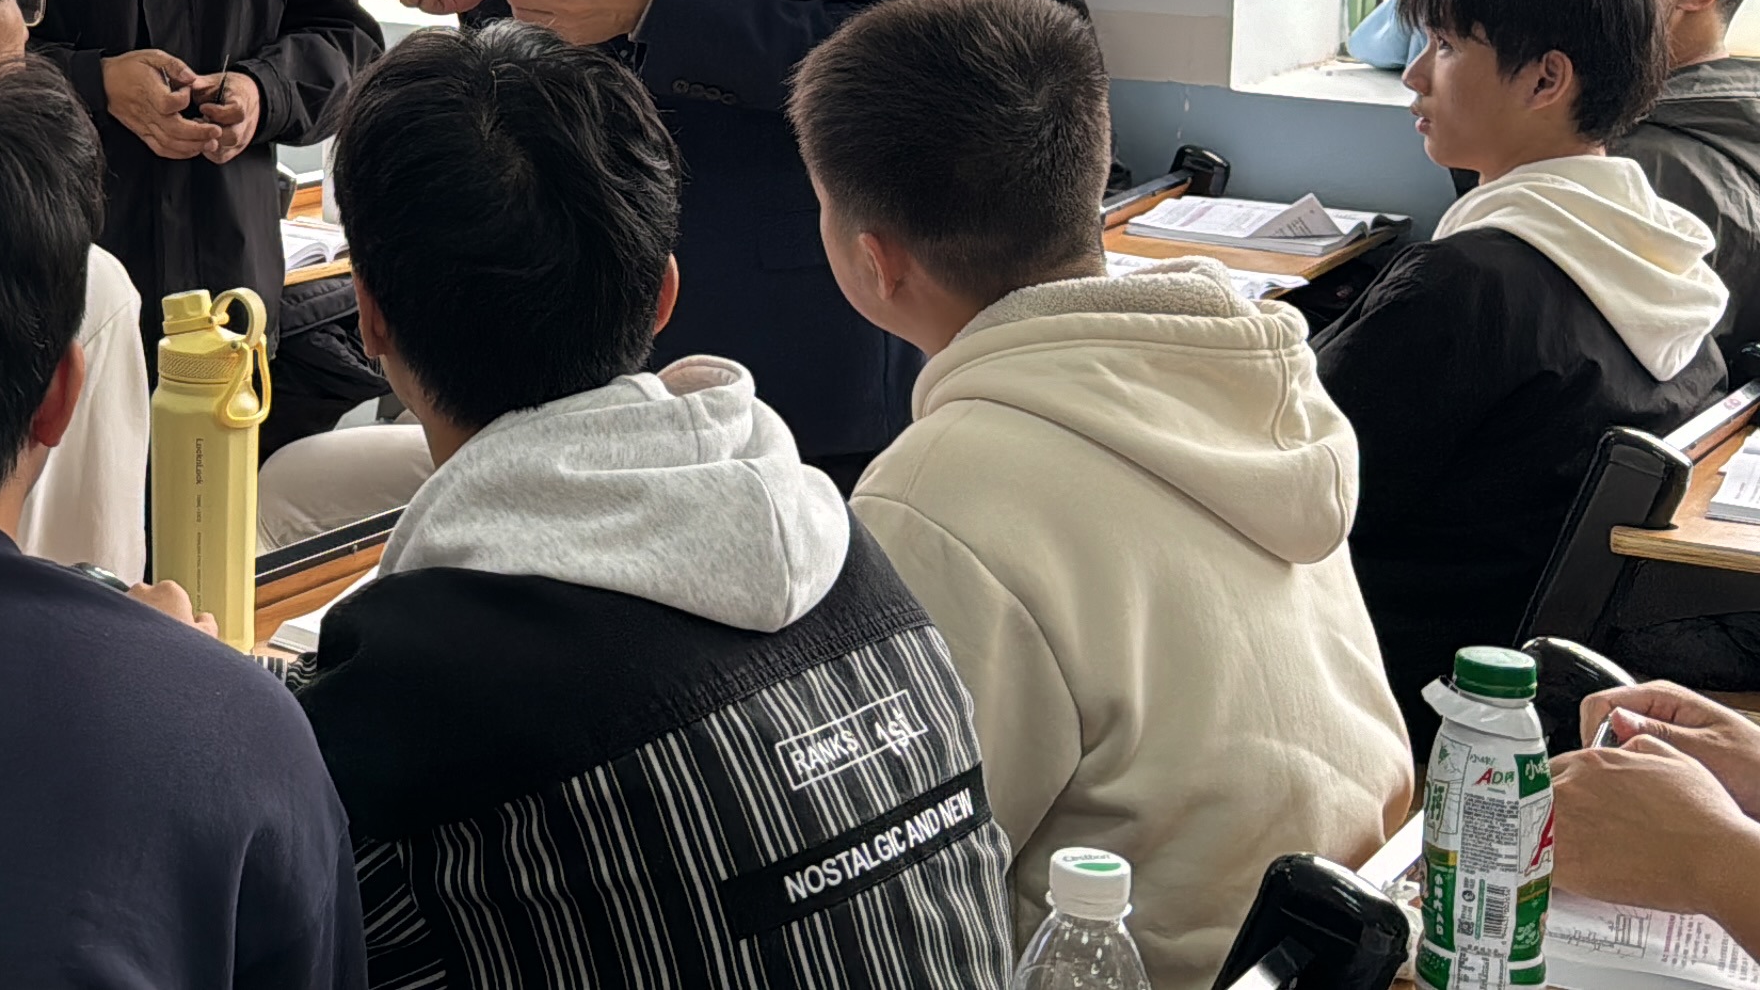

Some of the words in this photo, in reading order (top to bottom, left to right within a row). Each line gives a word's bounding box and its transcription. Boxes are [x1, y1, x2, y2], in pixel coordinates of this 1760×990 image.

[791, 730, 859, 775] RANKS
[783, 826, 907, 904] NOSTALGIC
[904, 808, 941, 848] AND
[938, 787, 975, 830] NEW
